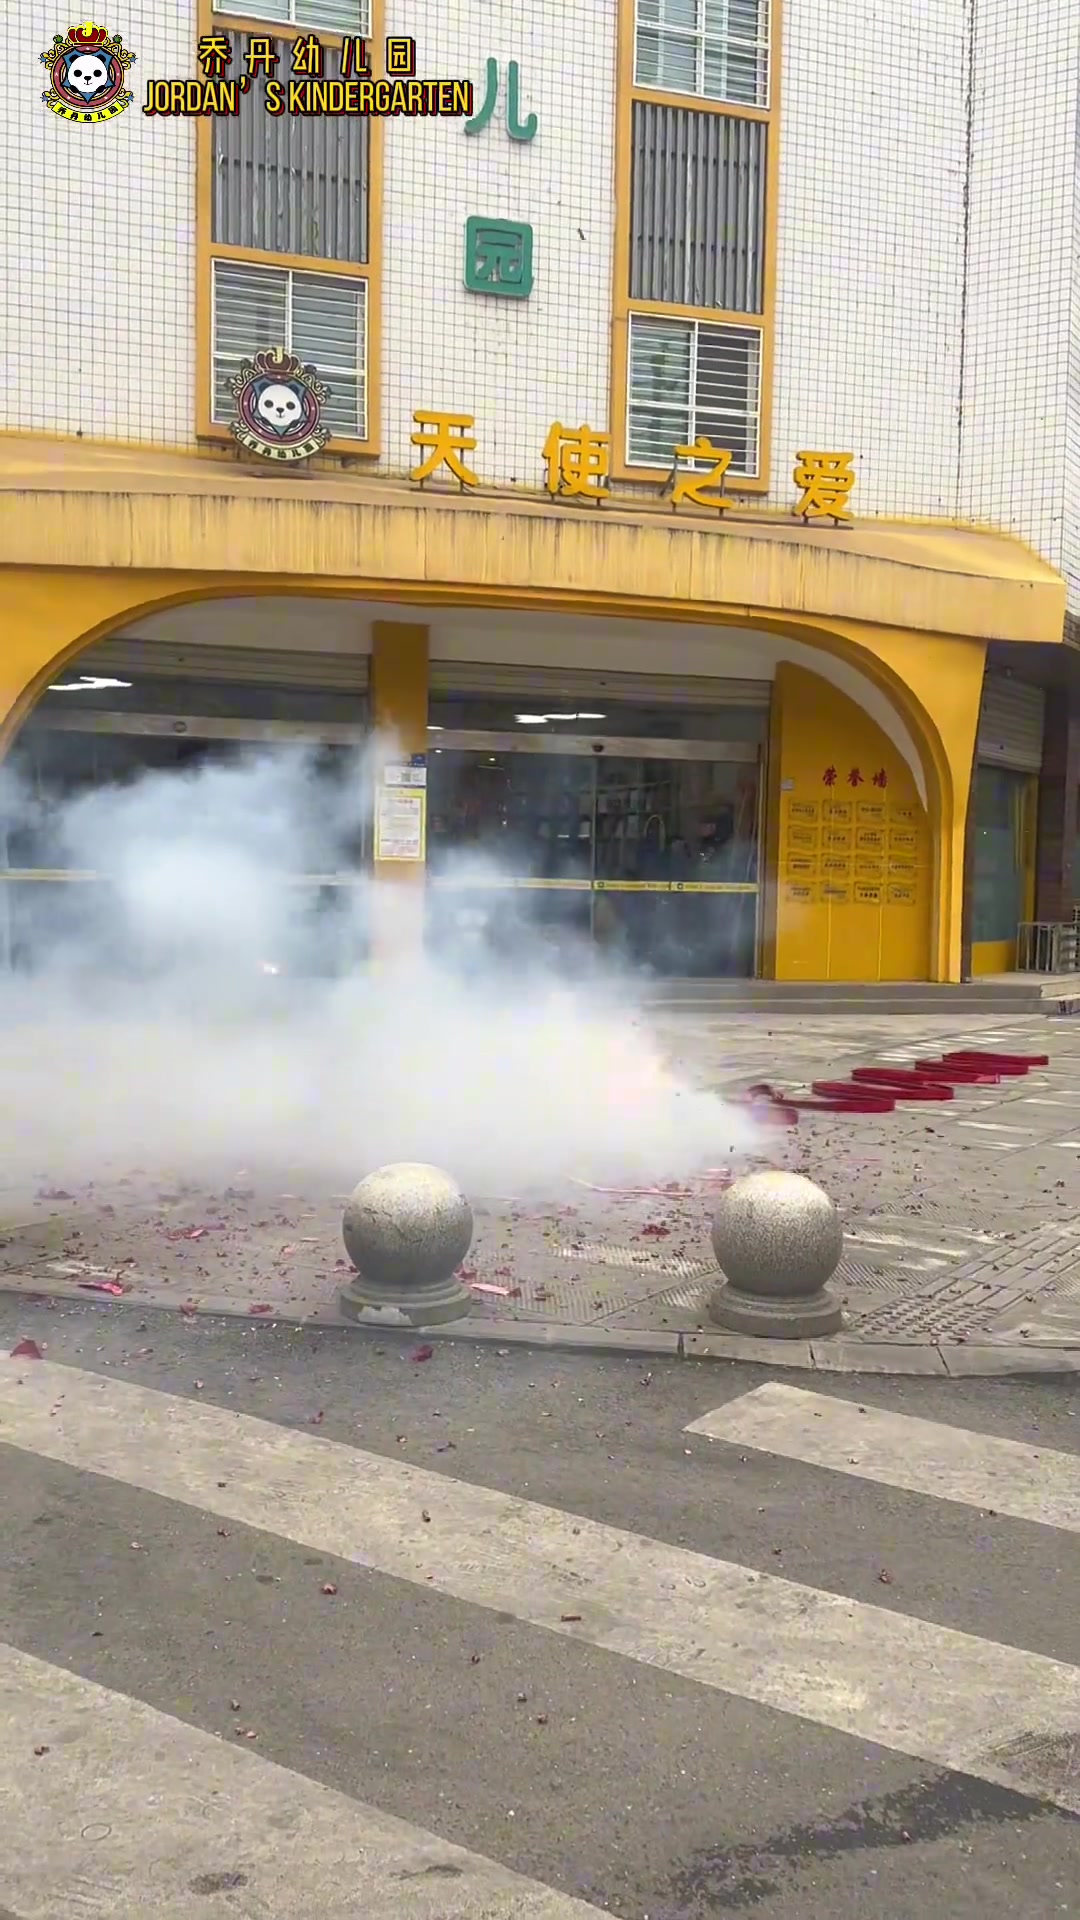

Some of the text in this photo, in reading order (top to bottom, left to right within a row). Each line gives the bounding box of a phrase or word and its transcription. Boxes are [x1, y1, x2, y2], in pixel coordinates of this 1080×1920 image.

[464, 57, 537, 297] 儿园
[410, 409, 855, 521] 天使之爱
